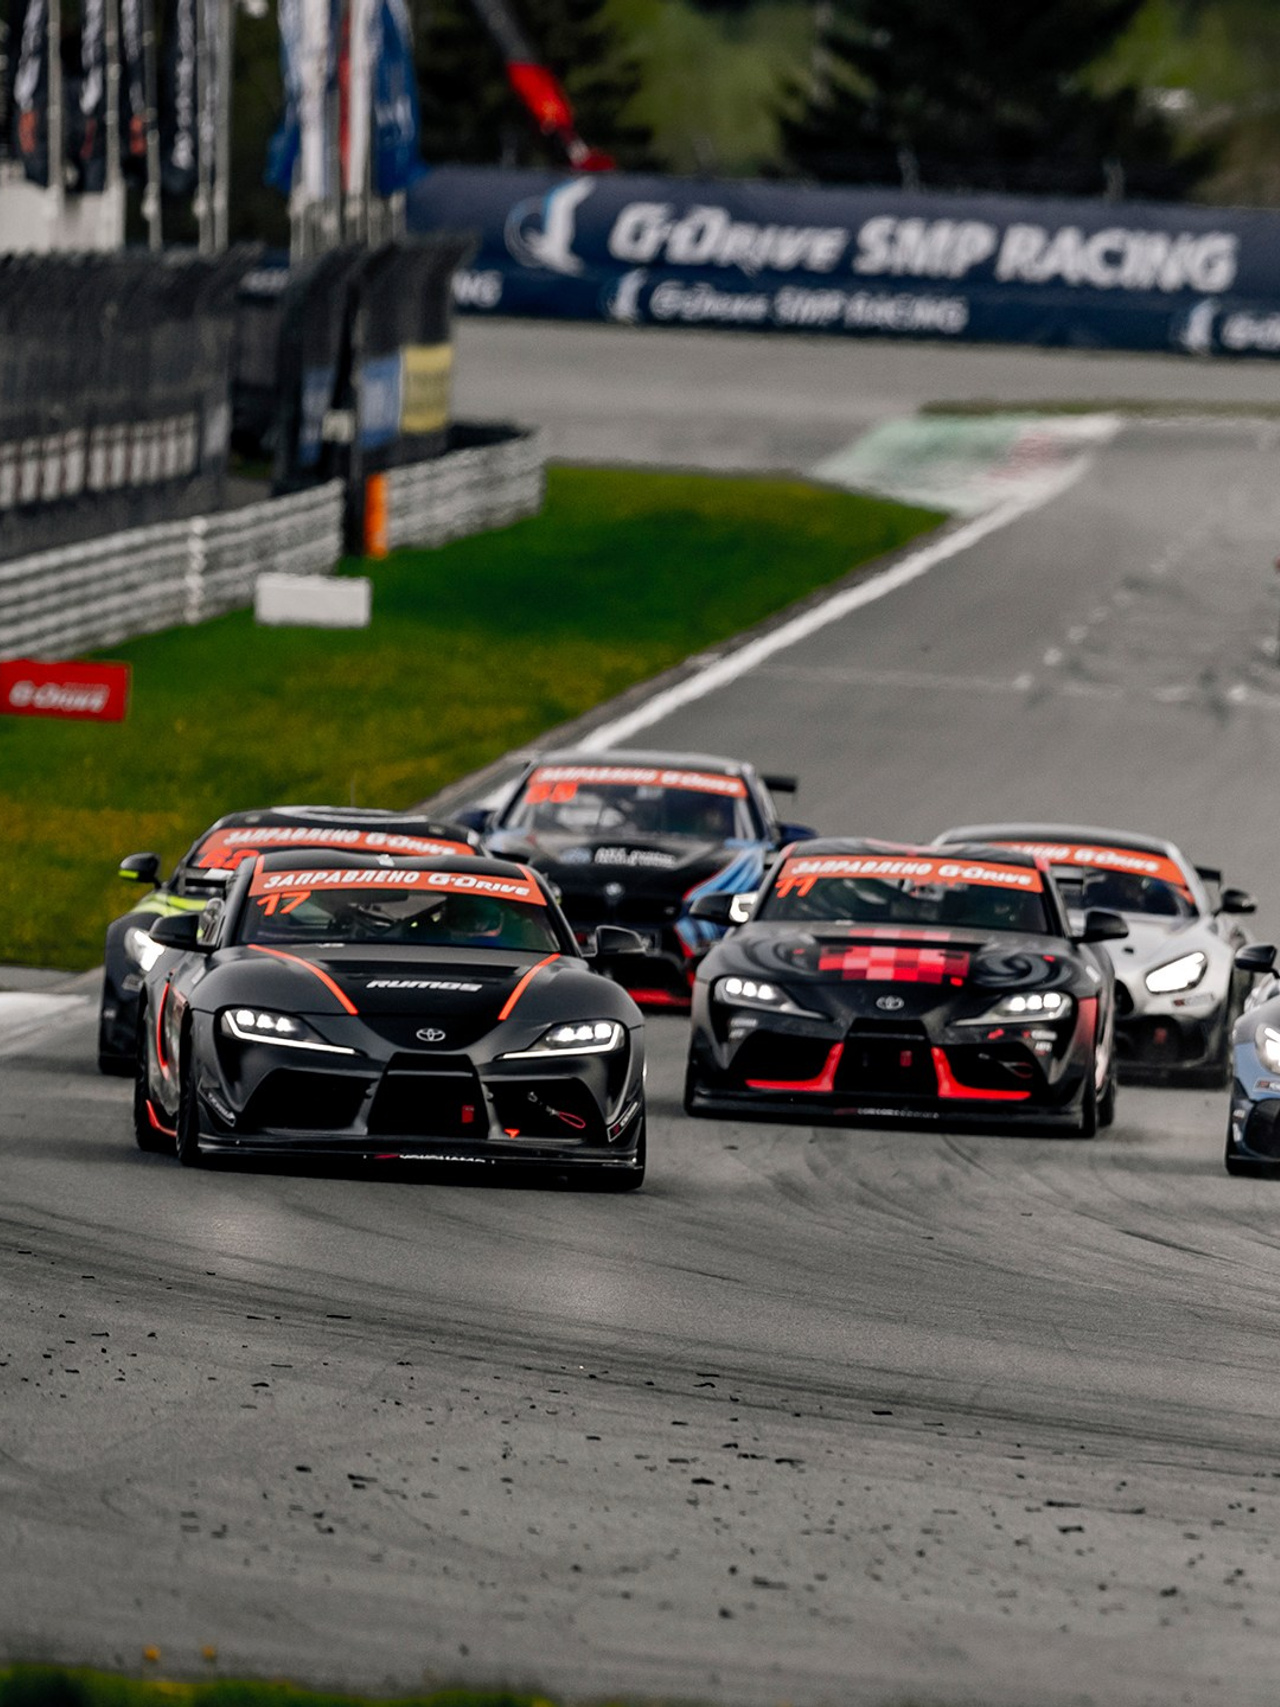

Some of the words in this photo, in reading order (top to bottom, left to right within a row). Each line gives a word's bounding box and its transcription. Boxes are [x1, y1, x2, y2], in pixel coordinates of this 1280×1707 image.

[852, 213, 998, 280] SMP
[995, 222, 1238, 293] RACING
[790, 859, 933, 876] ЗАПРАВЛЕНО
[263, 870, 421, 889] ЗАПРАВЛЕНО
[775, 876, 818, 898] 11
[256, 891, 312, 916] 17
